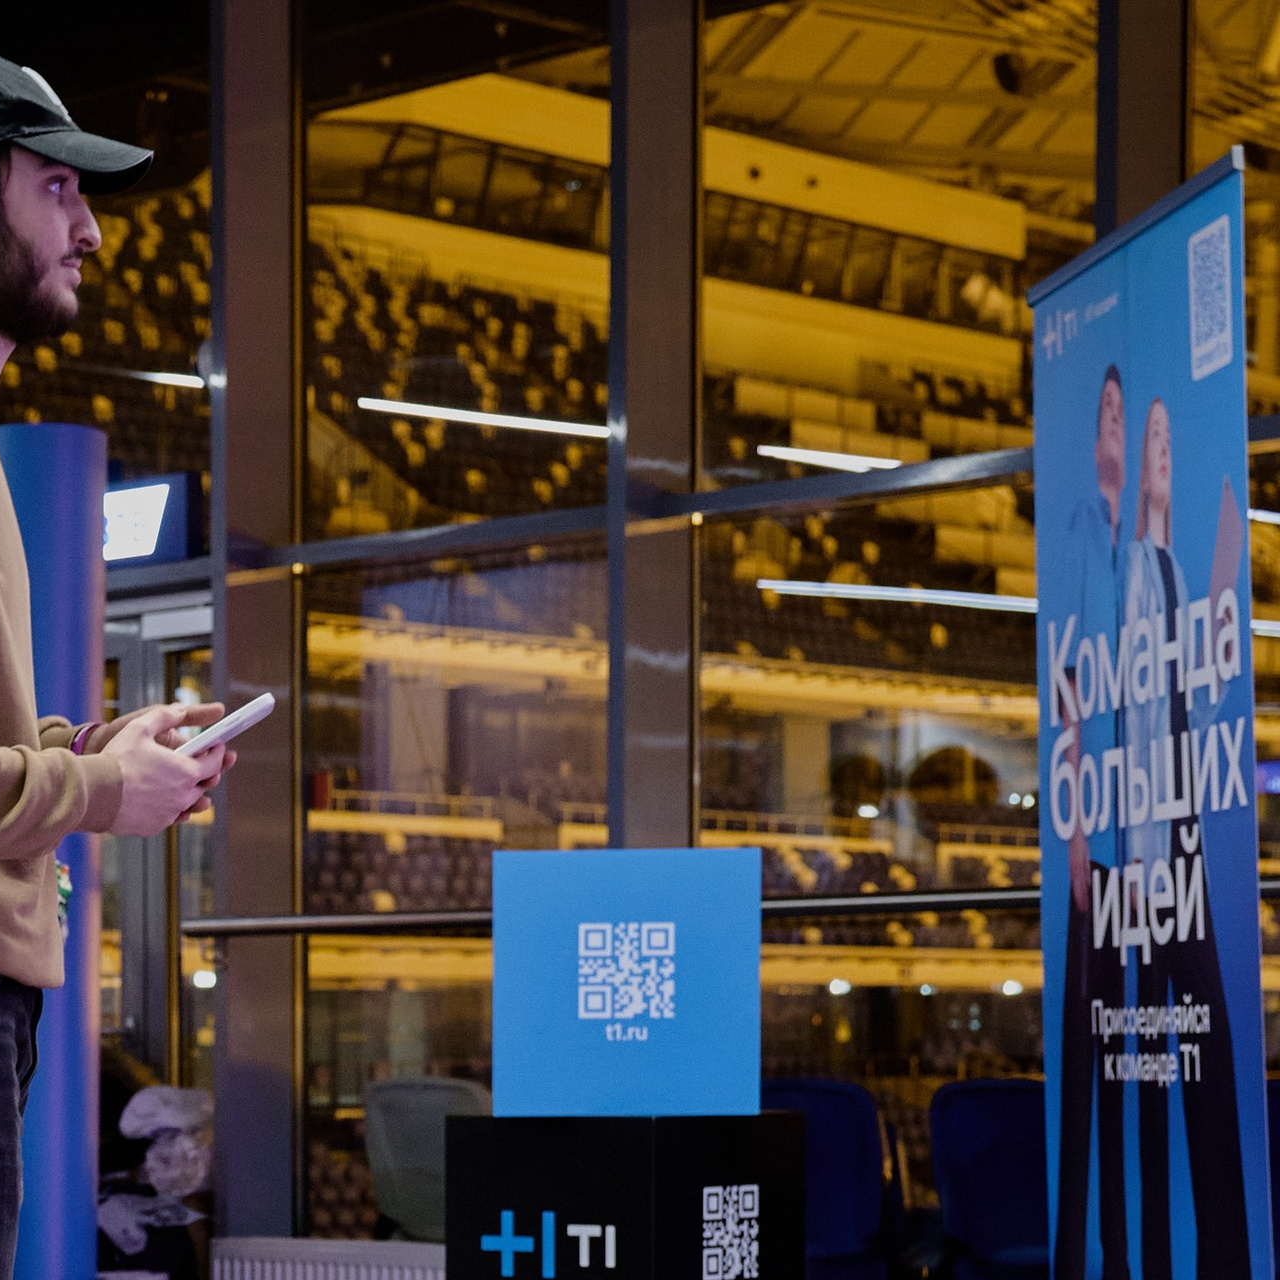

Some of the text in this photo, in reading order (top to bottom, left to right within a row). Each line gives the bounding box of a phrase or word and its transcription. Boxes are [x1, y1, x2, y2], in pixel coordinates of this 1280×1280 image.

[1048, 588, 1242, 728] Команда
[1050, 716, 1249, 842] больших
[1092, 823, 1206, 967] идей
[605, 1022, 649, 1041] t1.ru
[1091, 993, 1212, 1044] Присоединяйся
[1103, 1053, 1115, 1082] к
[1116, 1048, 1180, 1088] команде
